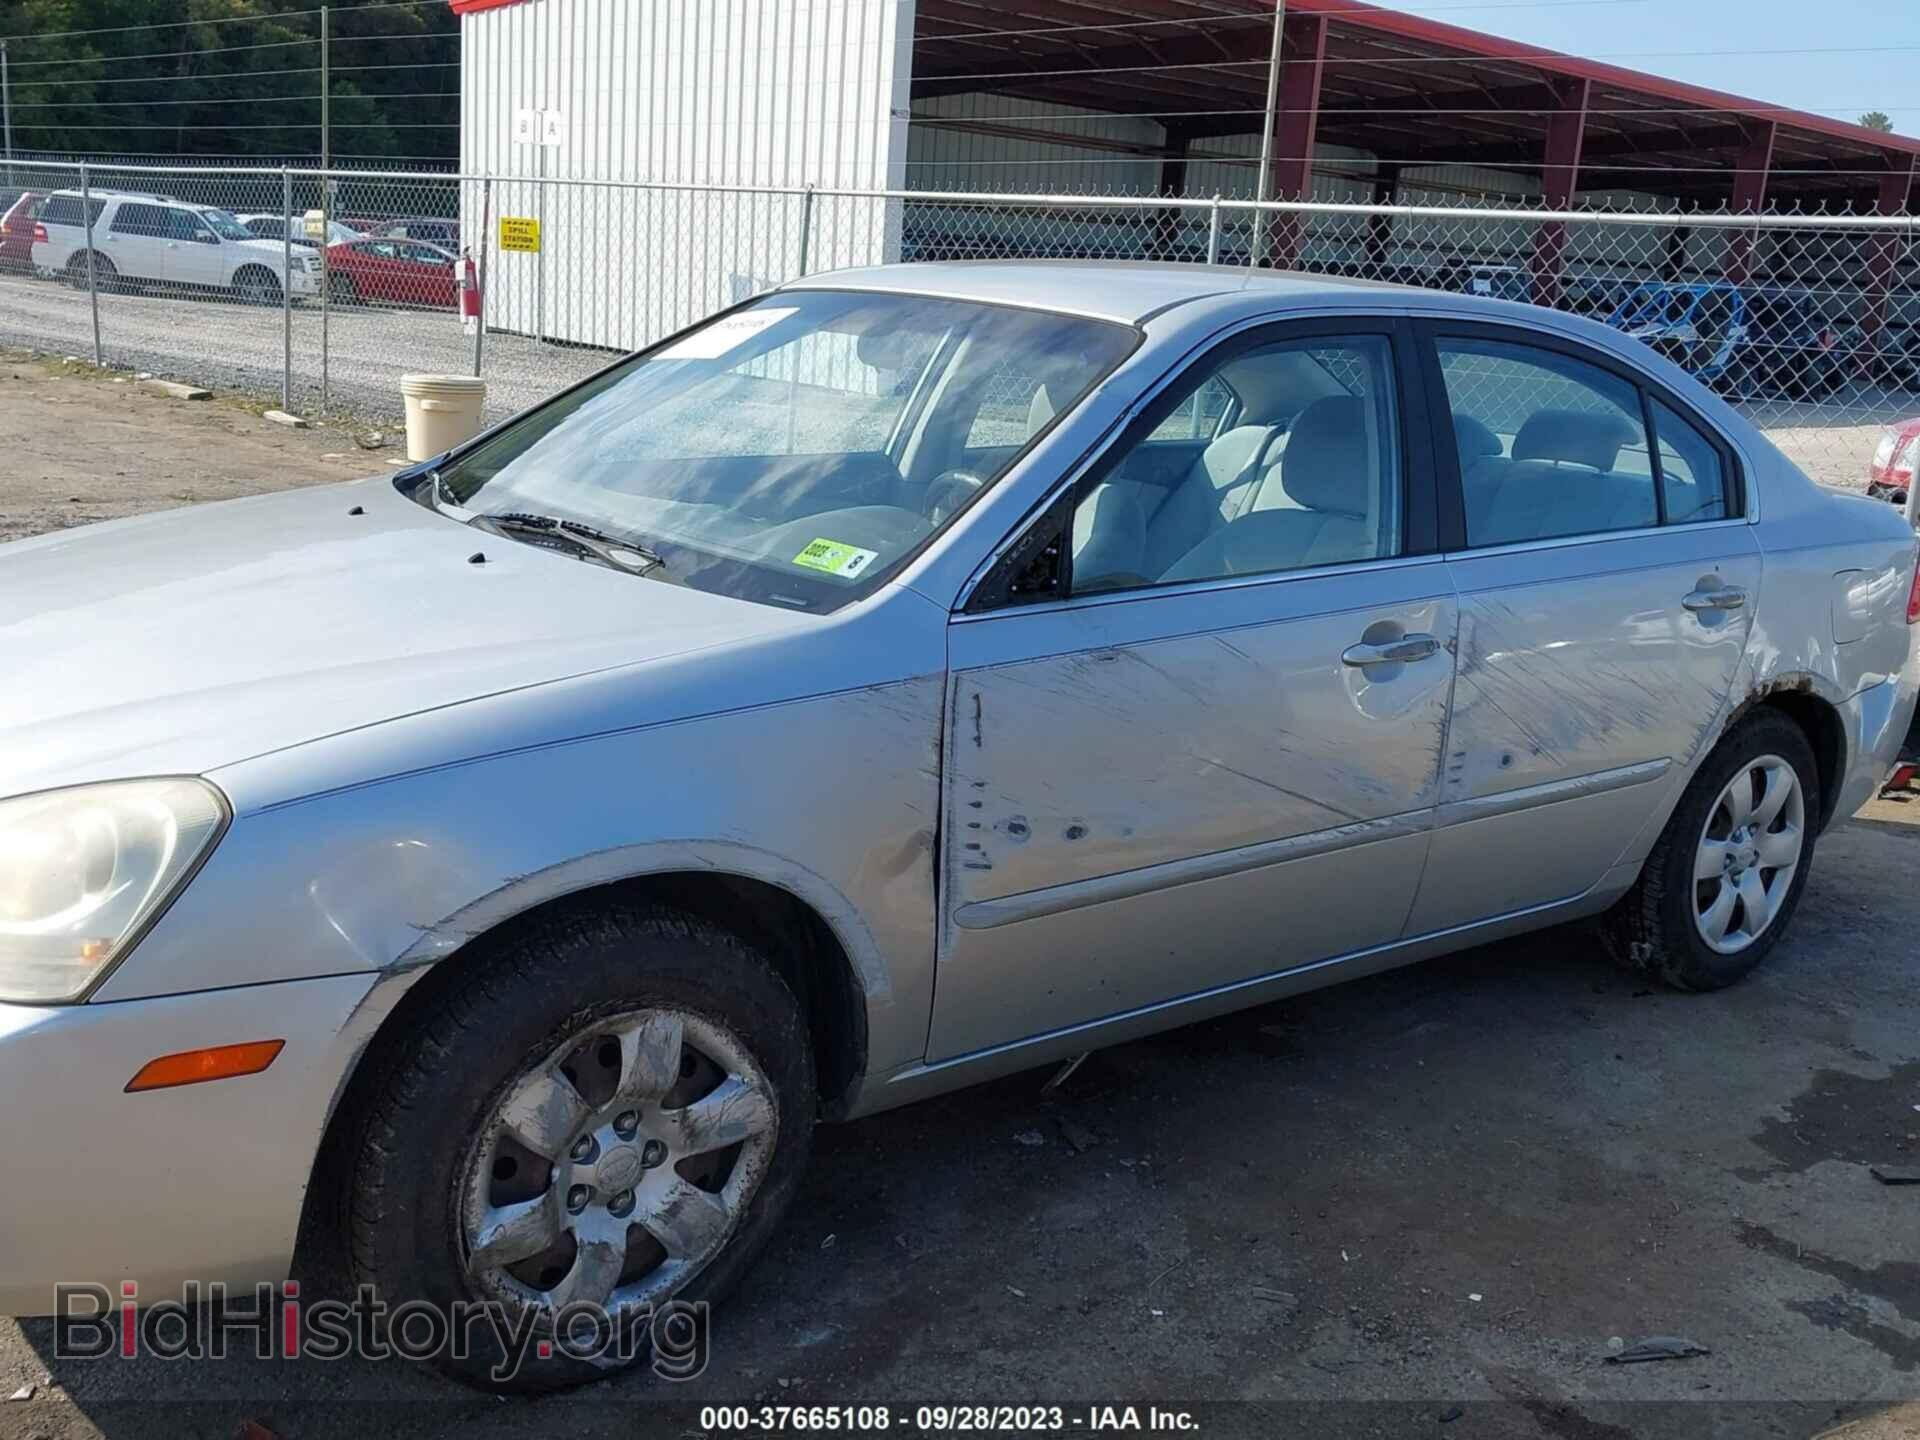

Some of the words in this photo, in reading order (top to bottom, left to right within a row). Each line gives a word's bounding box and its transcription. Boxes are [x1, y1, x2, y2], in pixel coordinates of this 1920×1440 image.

[547, 121, 557, 136] A
[508, 226, 529, 234] SPILL
[503, 235, 534, 243] STATION
